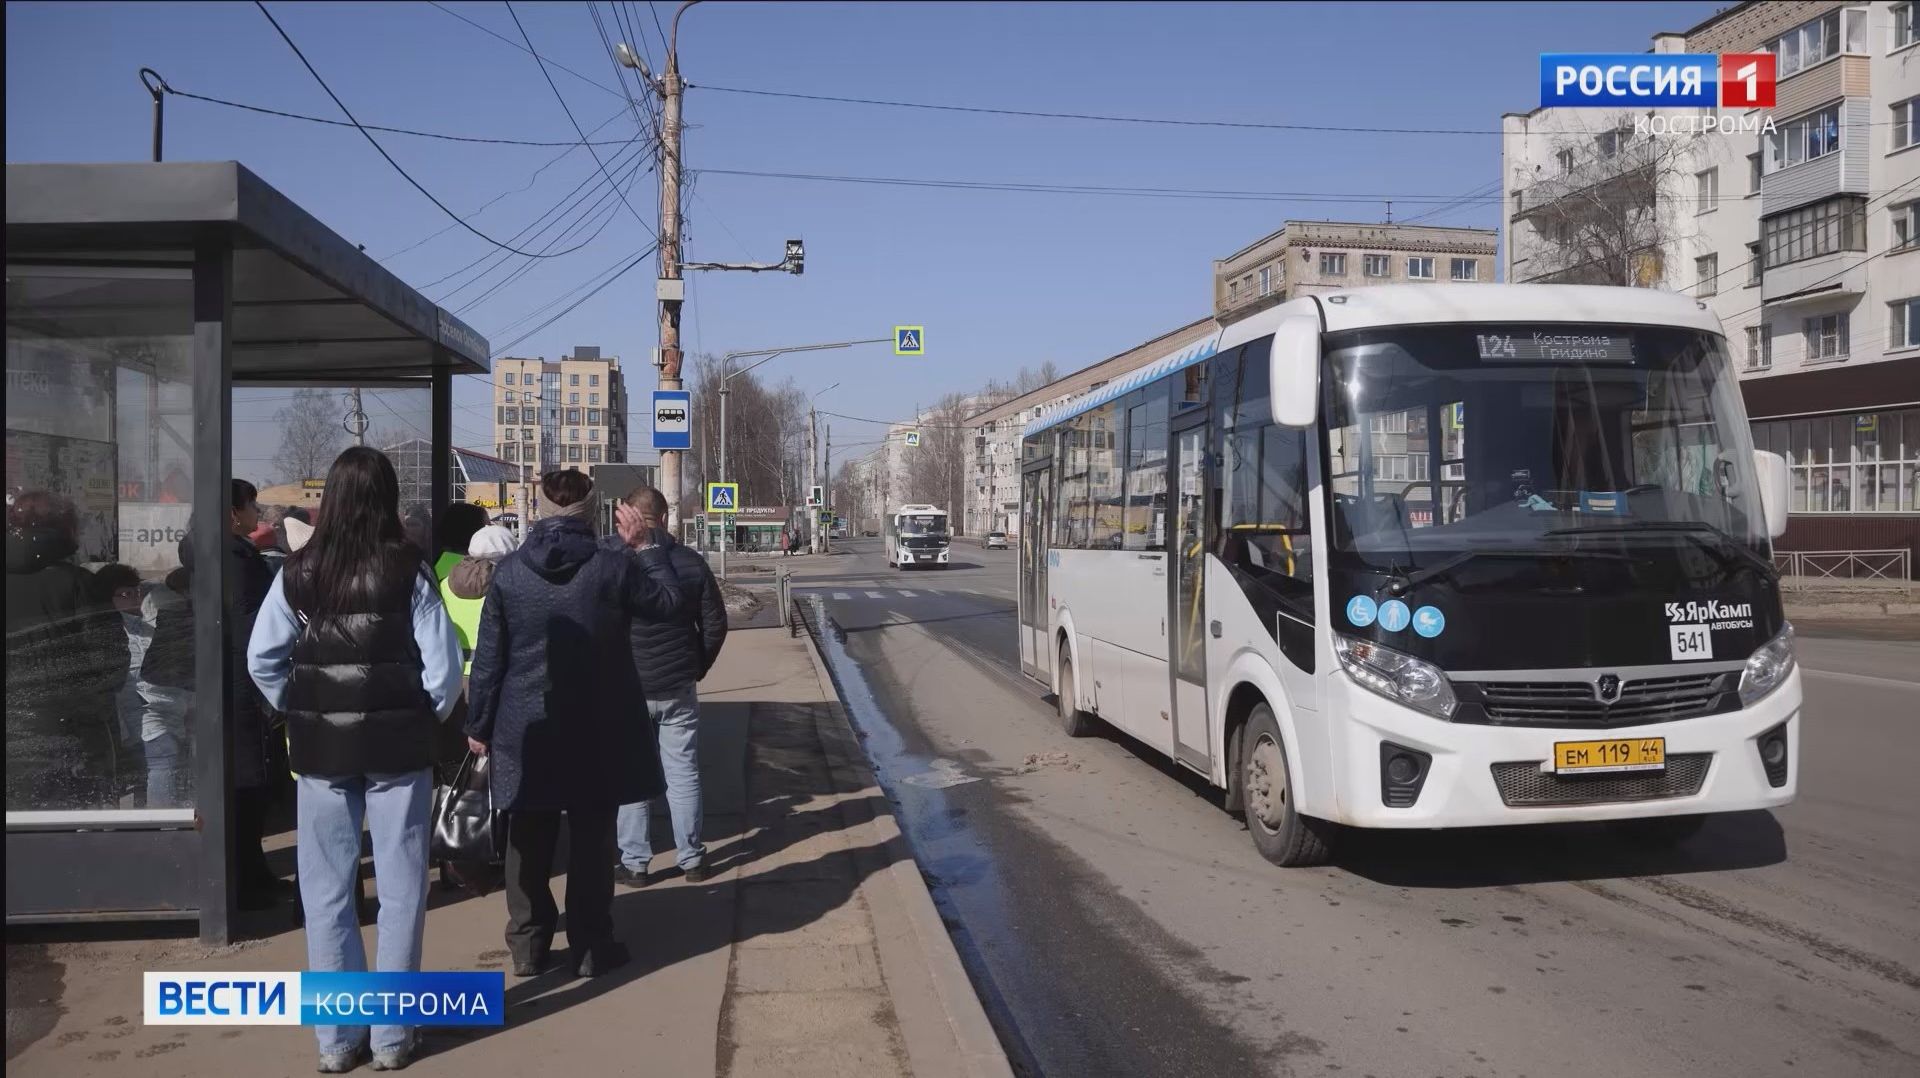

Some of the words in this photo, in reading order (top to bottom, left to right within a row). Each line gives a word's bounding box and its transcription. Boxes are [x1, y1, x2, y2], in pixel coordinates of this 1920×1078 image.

[1477, 334, 1516, 359] 124
[1533, 332, 1611, 346] Кострома
[1540, 345, 1608, 359] Гридино
[1686, 600, 1752, 624] ЯрКамп
[1711, 620, 1753, 631] АВТОБУСЫ
[1677, 632, 1706, 653] 541
[1598, 744, 1630, 763] 119
[1641, 741, 1658, 756] 44
